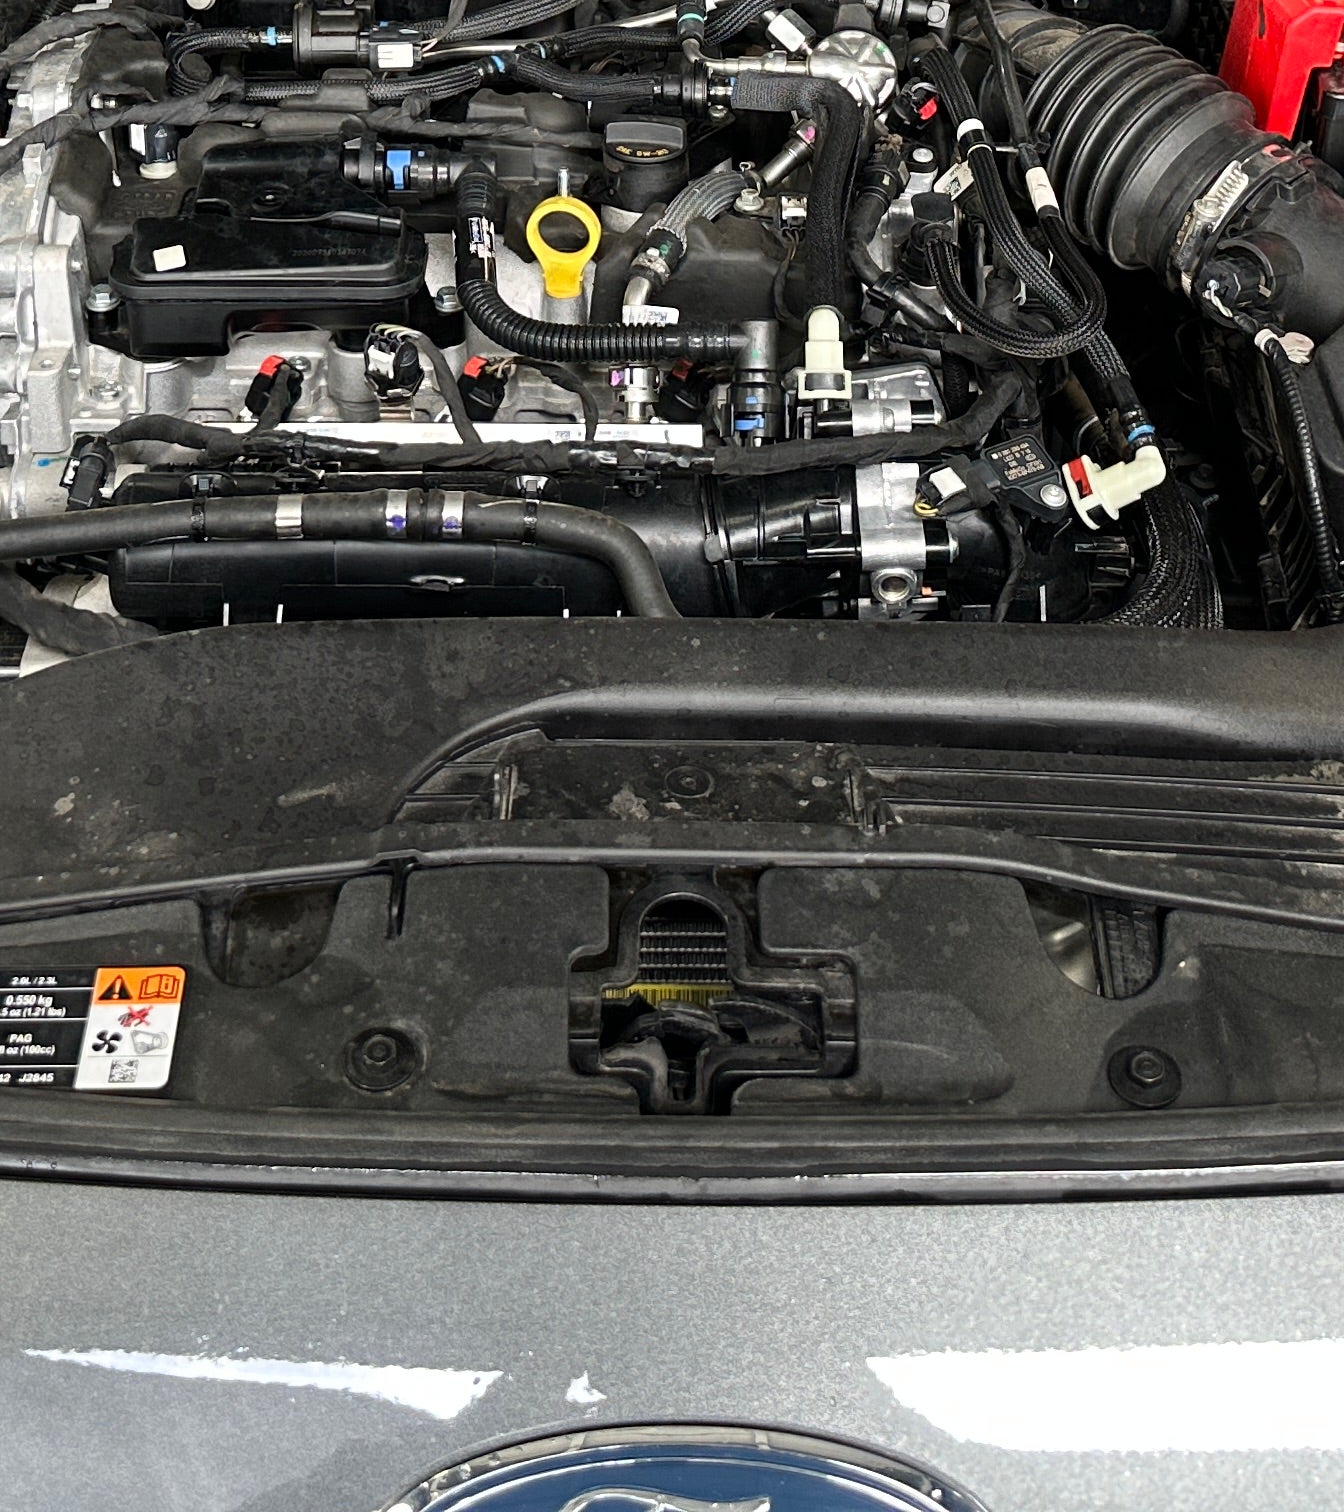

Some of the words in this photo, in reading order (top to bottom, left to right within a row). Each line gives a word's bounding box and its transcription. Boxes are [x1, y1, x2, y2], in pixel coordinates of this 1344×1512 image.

[5, 994, 37, 1006] 0.550
[38, 994, 54, 1007] kg
[9, 1008, 22, 1017] oz
[47, 1007, 67, 1018] lbs)
[9, 1033, 33, 1044] PAG
[6, 1046, 19, 1055] oz
[18, 1072, 55, 1083] J2845
